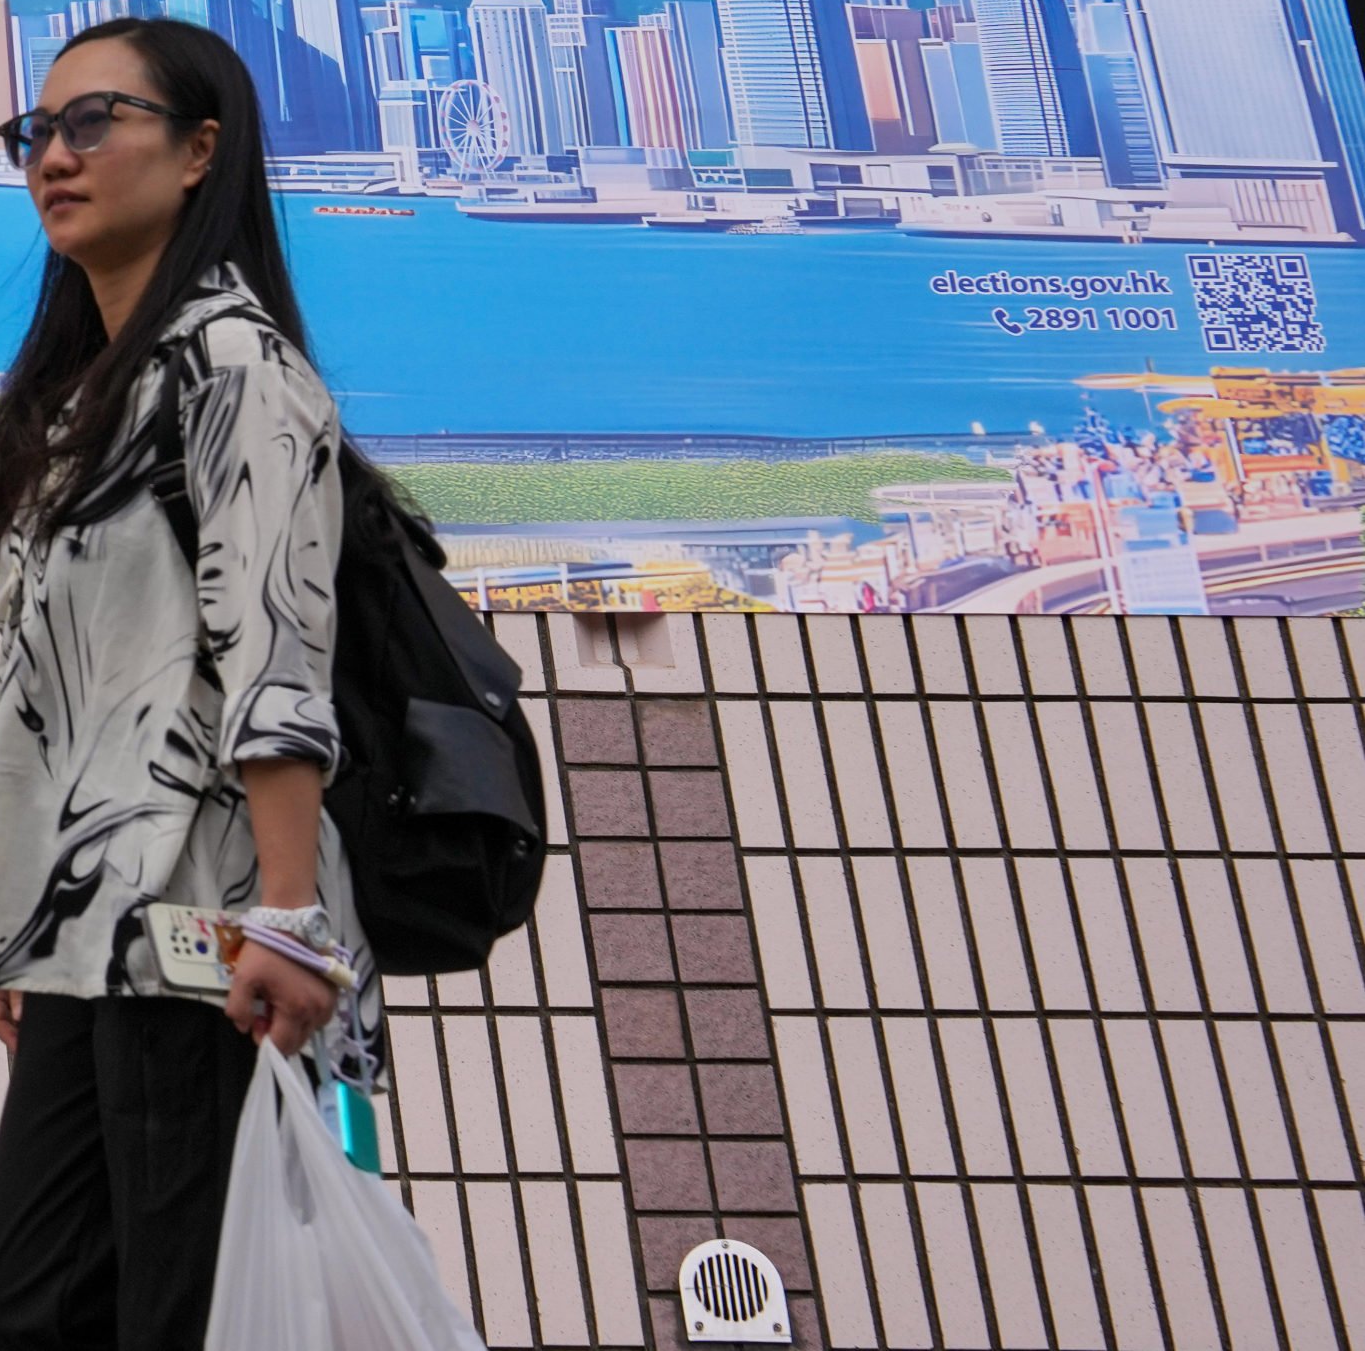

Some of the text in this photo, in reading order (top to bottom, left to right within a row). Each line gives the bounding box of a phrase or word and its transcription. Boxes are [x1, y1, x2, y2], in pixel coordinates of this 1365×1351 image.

[931, 272, 1171, 300] elections.gov.hk
[1027, 309, 1176, 330] 2891 1001
